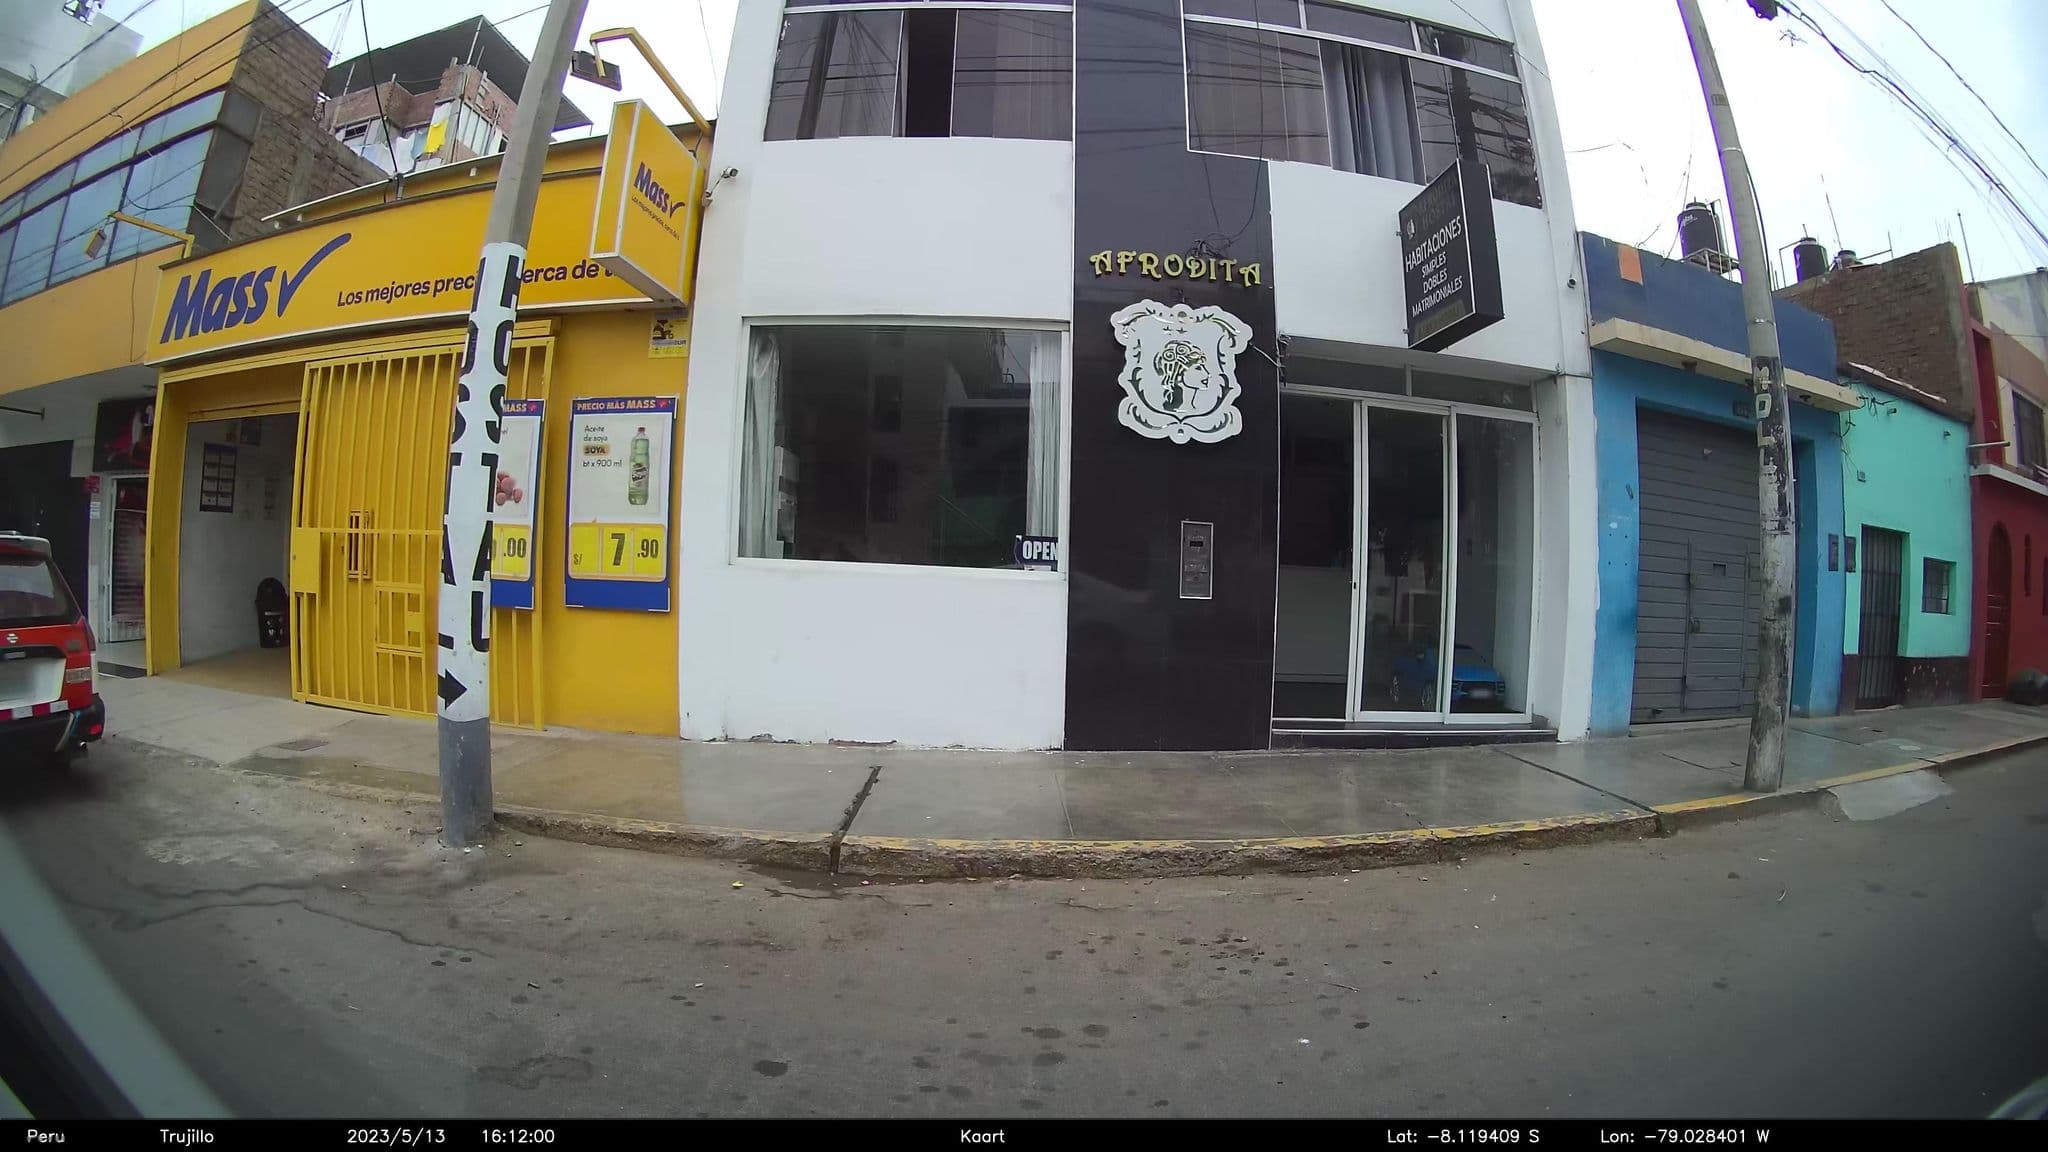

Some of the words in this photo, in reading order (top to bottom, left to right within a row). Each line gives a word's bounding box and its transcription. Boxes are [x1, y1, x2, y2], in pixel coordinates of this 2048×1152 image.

[633, 161, 670, 213] Mass
[1405, 215, 1462, 272] HABITACIONES
[1089, 250, 1262, 287] AFRODITA
[1421, 251, 1447, 278] SIMPLES
[1423, 268, 1448, 294] DOBLES
[337, 291, 362, 307] Los
[365, 280, 430, 305] mejores
[433, 274, 477, 298] prec
[521, 263, 567, 284] erca
[572, 259, 600, 280] de
[1412, 275, 1463, 318] MATRIMONIALES
[160, 266, 277, 344] Mass
[577, 401, 605, 410] PRECIO
[626, 399, 656, 409] MASS
[596, 459, 612, 467] 900
[573, 553, 583, 566] S/
[610, 533, 626, 566] 7
[1022, 540, 1058, 560] OPEN
